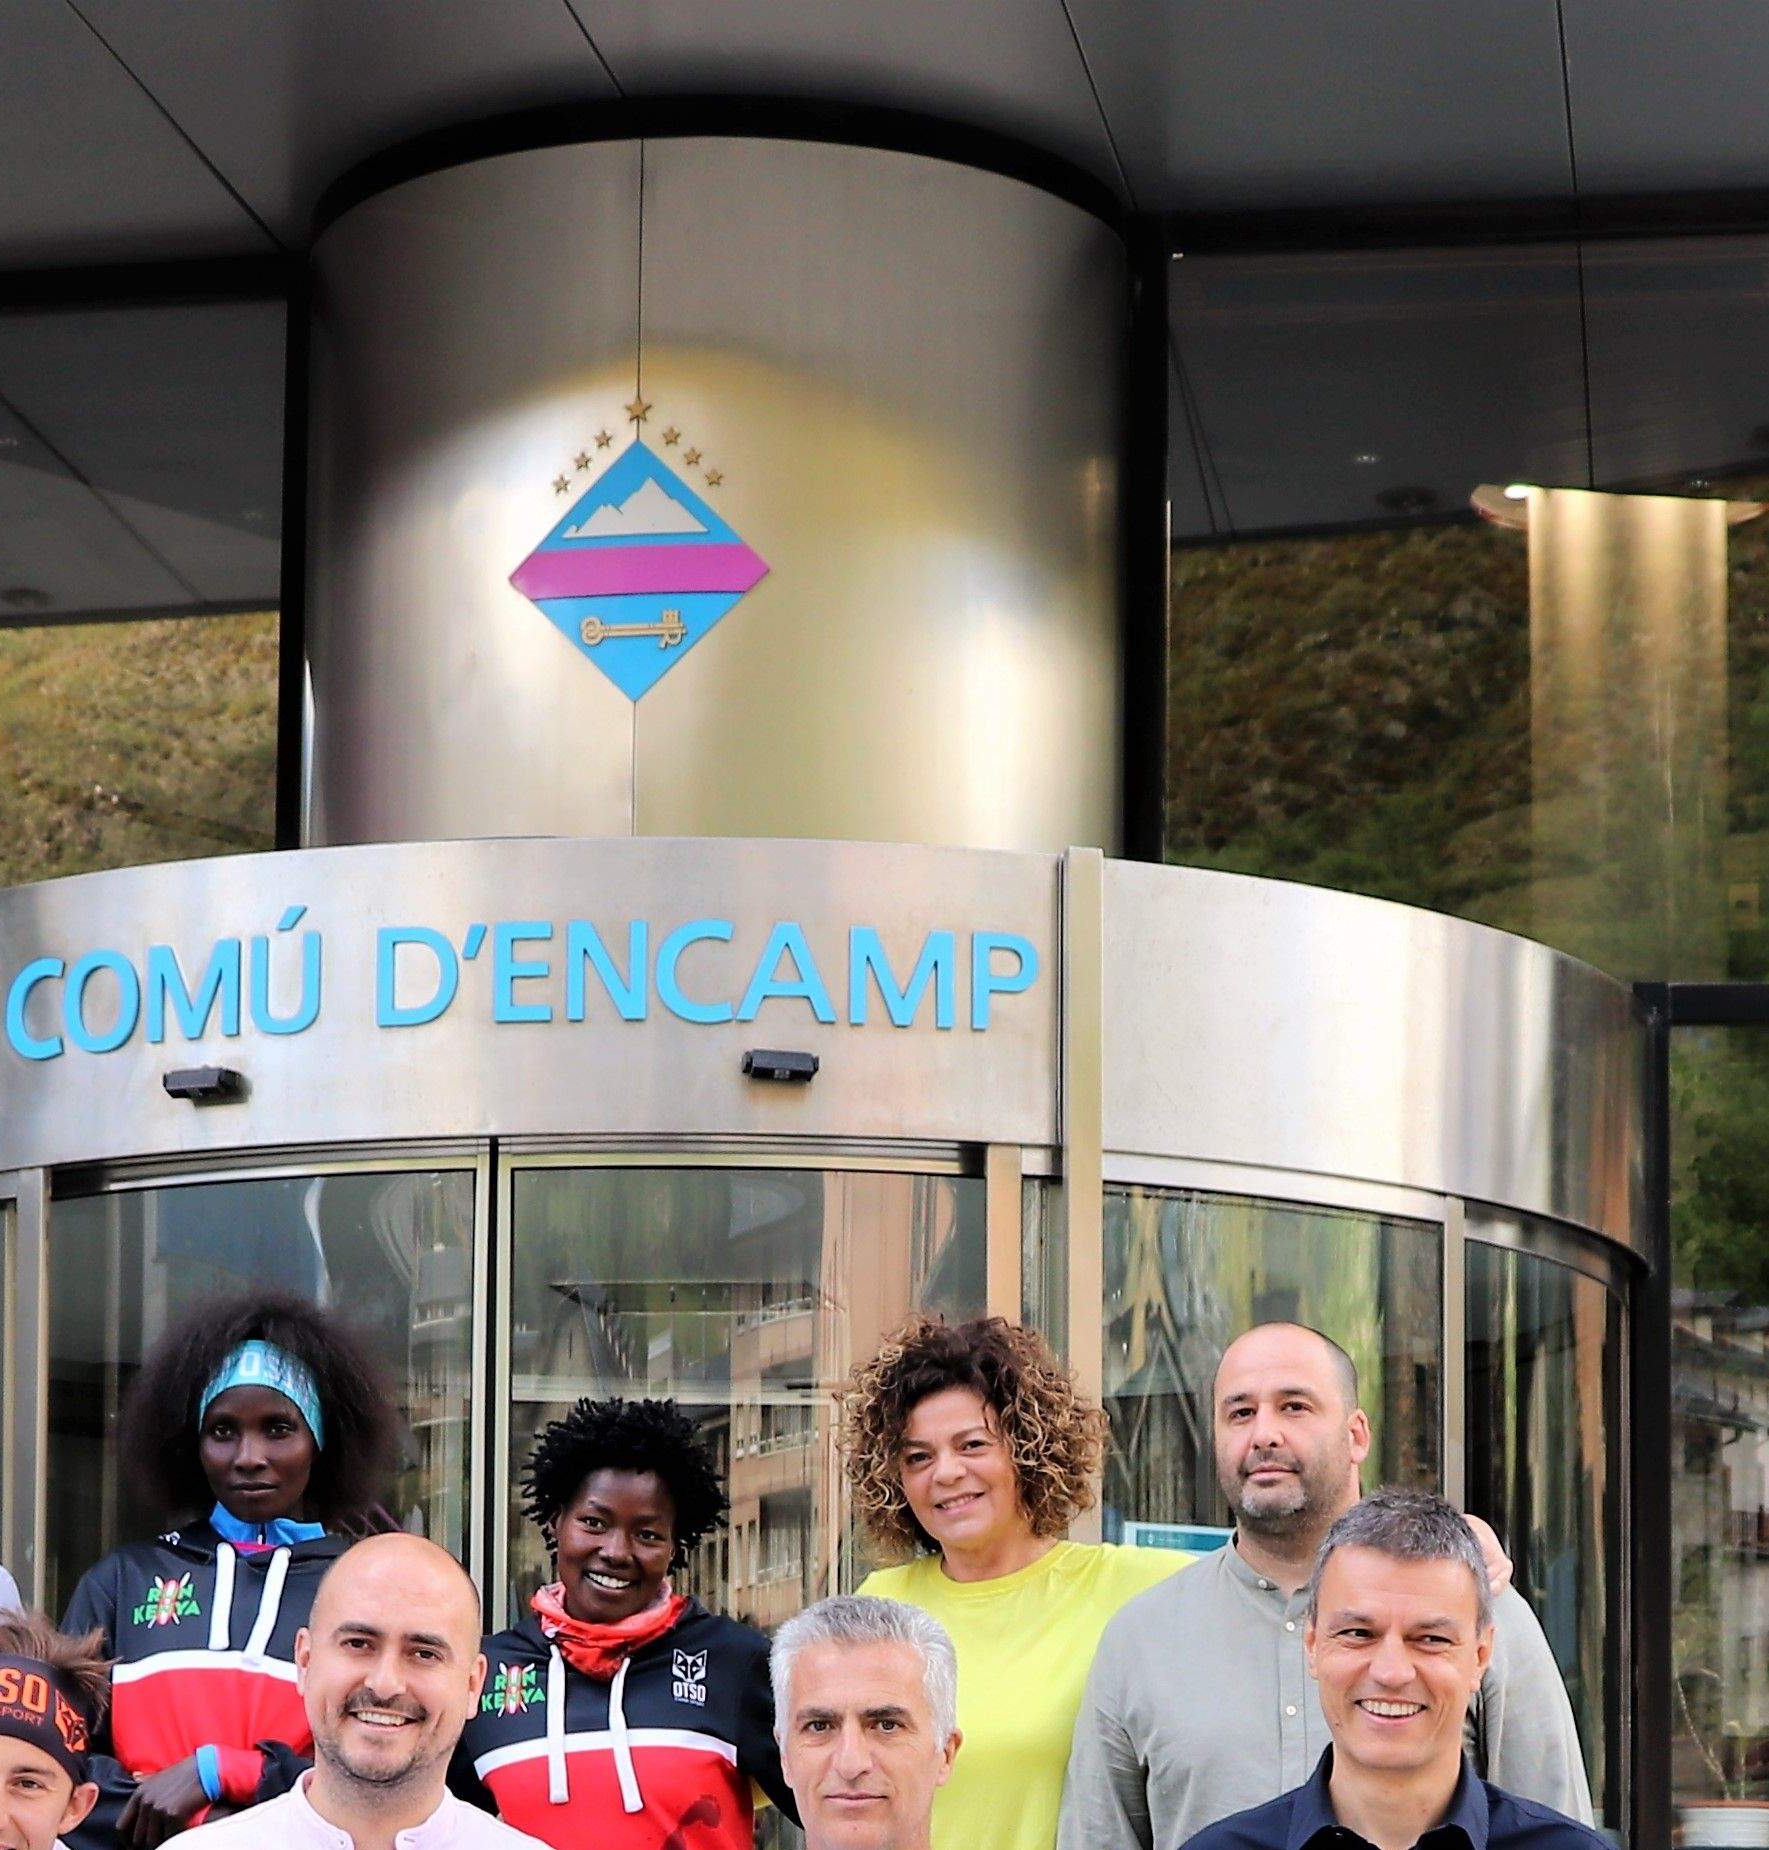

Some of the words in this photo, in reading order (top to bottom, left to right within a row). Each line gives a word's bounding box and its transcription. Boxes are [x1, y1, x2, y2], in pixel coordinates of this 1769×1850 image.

[4, 905, 322, 1060] COMÚ
[374, 917, 1040, 1032] D'ENCAMP
[672, 1680, 707, 1703] OTSO
